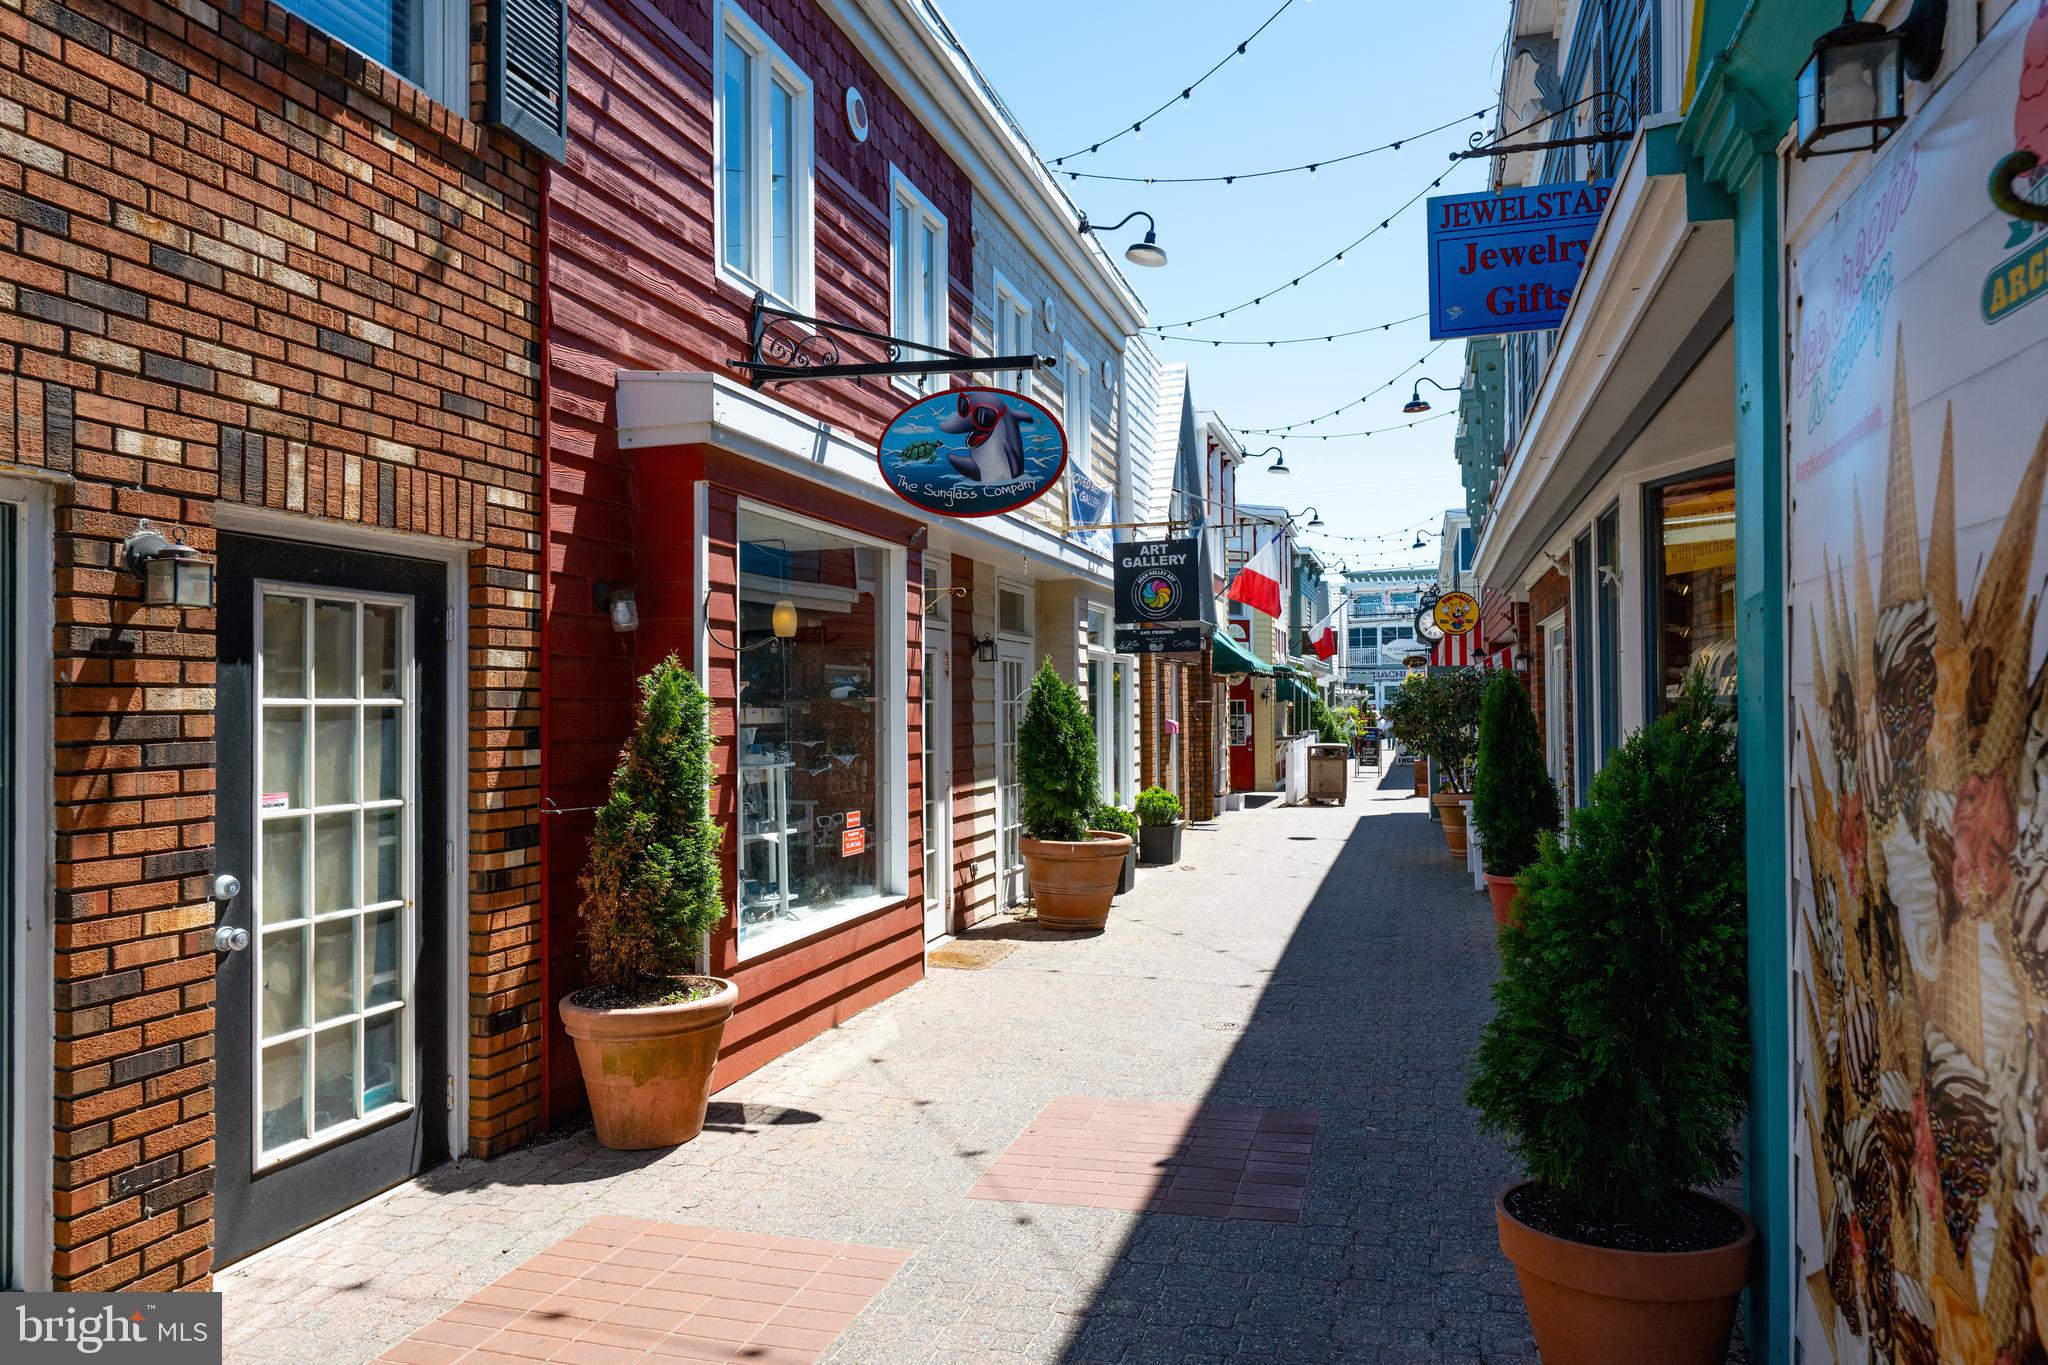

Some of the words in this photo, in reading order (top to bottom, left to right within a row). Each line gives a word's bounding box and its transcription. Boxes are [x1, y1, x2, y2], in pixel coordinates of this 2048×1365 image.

[1990, 246, 2048, 315] ARC
[1486, 282, 1573, 317] Gifts
[897, 475, 918, 493] The
[923, 483, 978, 507] Sunglass
[983, 479, 1036, 497] Company
[1122, 554, 1187, 568] GALLERY
[1139, 543, 1169, 556] ART
[1671, 544, 1691, 561] with
[1693, 538, 1734, 564] purchase
[1166, 572, 1176, 582] ART
